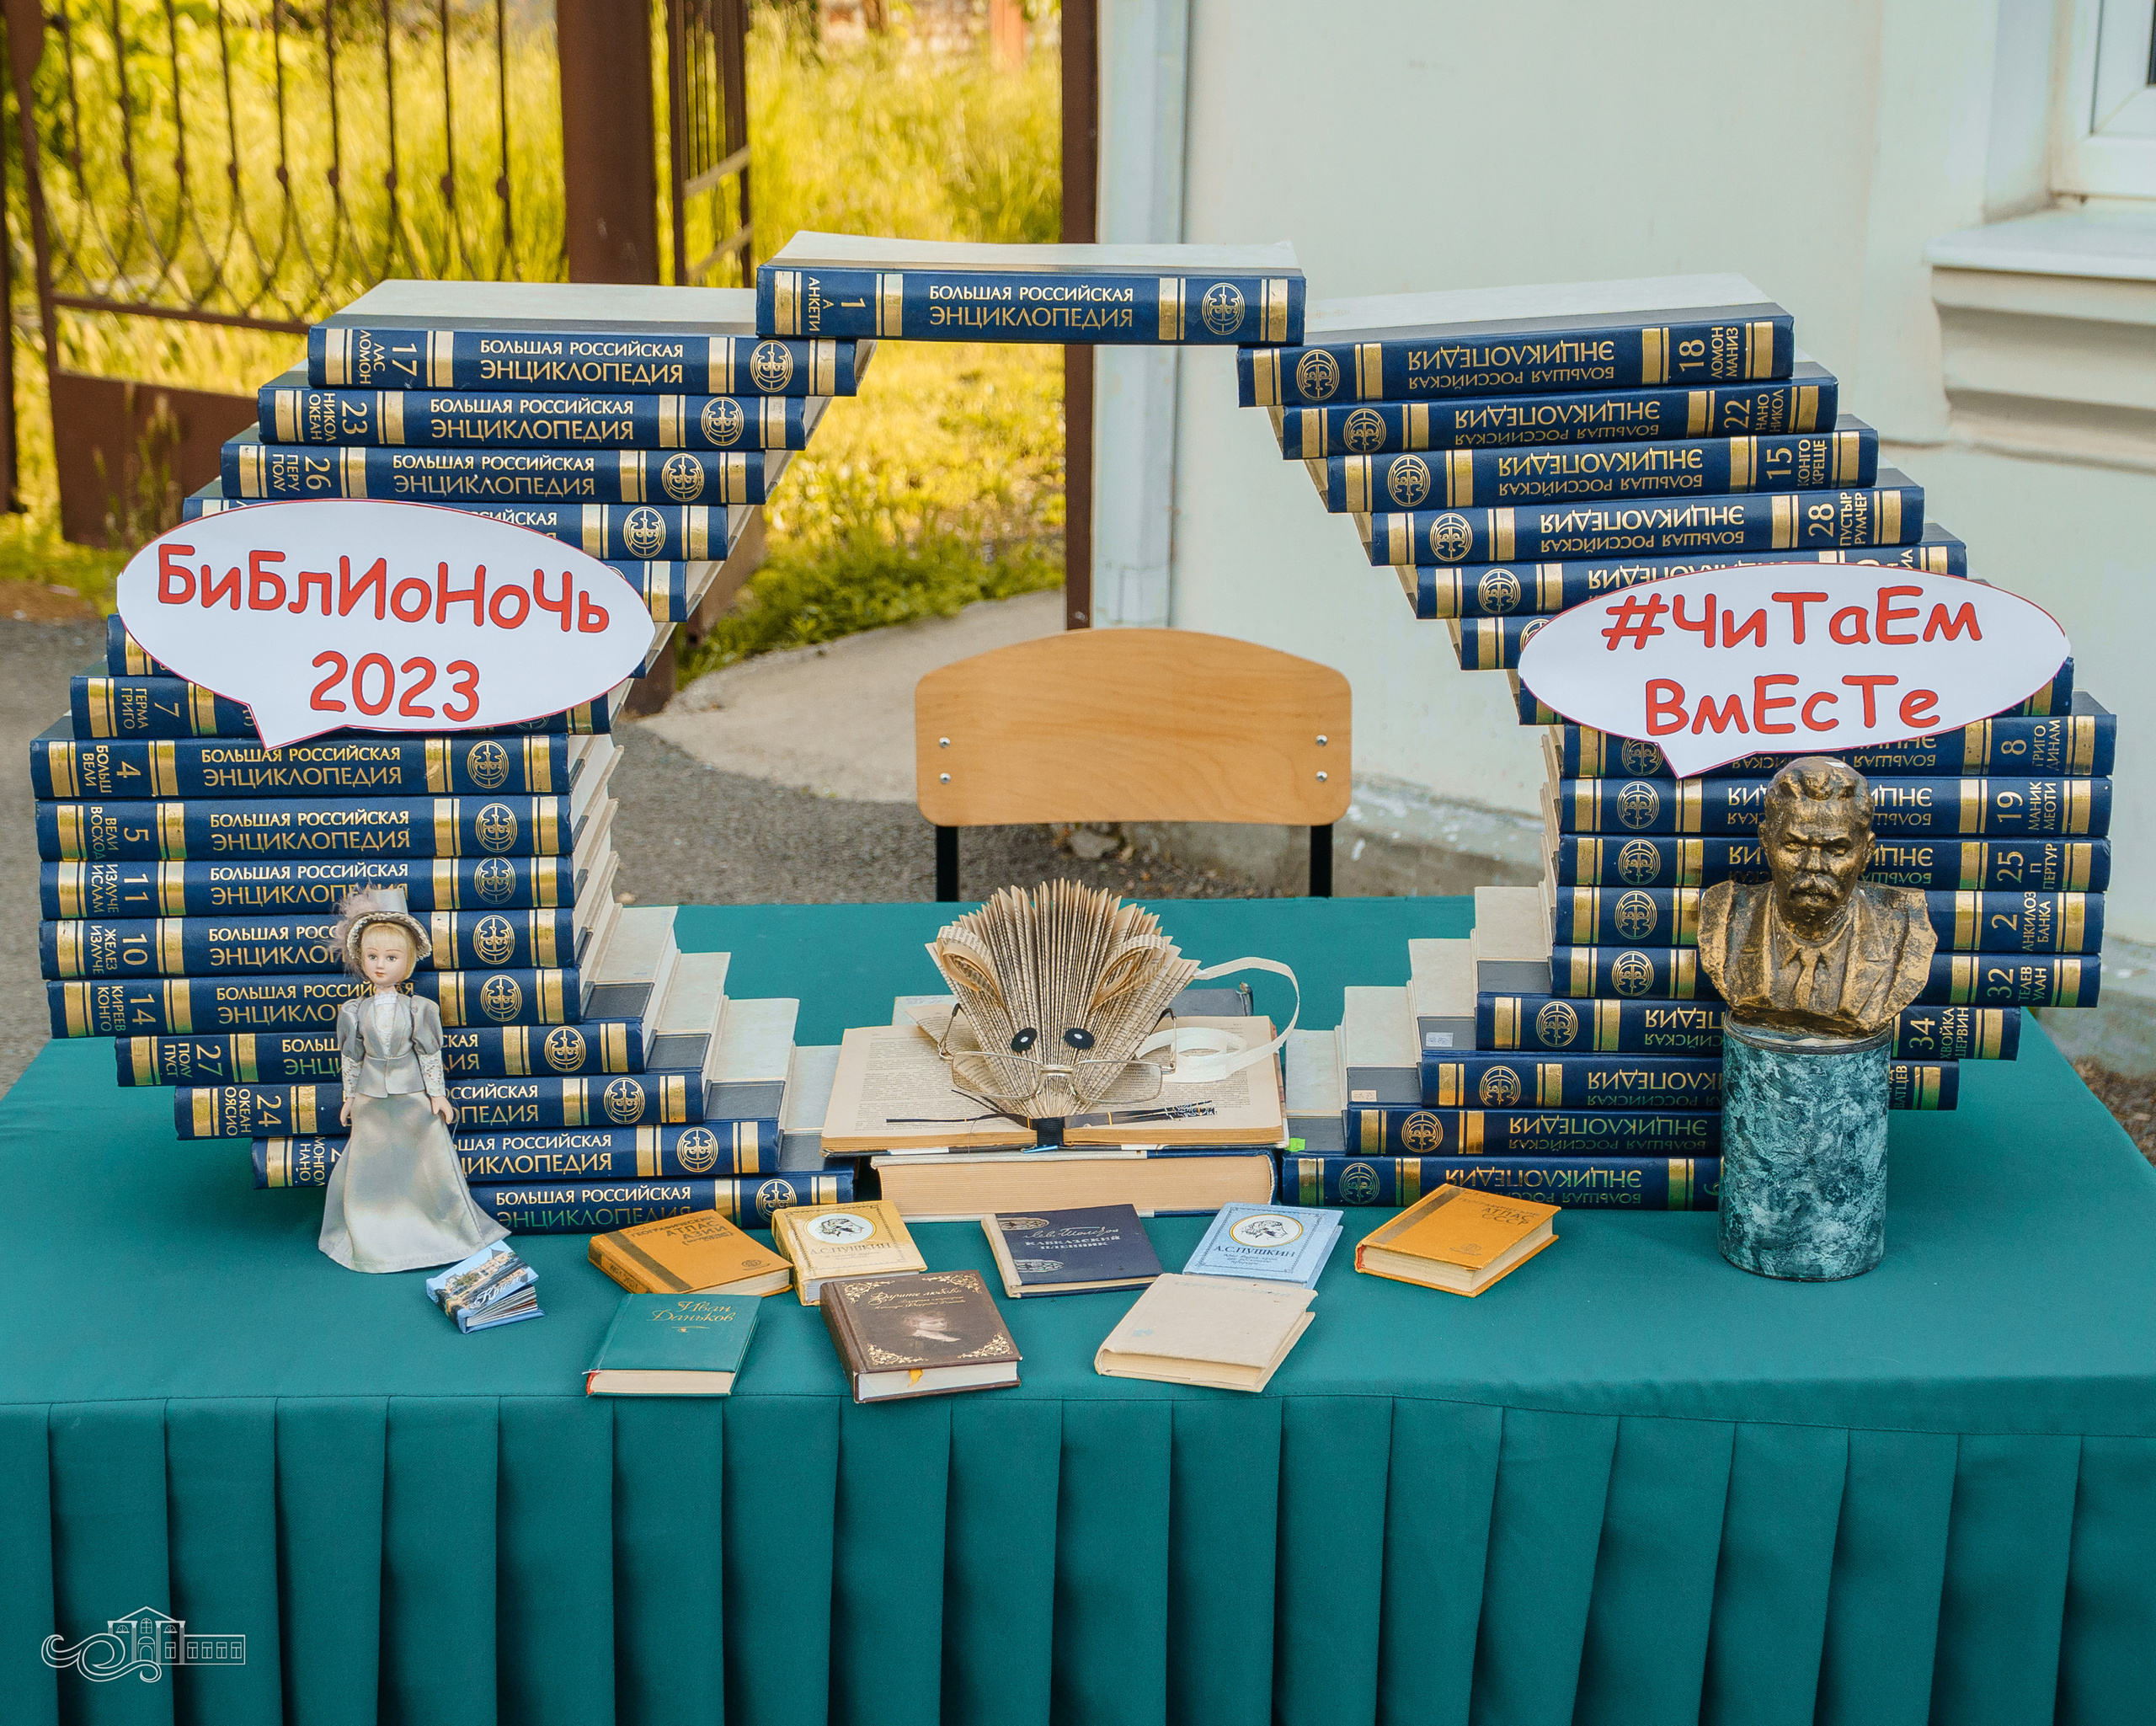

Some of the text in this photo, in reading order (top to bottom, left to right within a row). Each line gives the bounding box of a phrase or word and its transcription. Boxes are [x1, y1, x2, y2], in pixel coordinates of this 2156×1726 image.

[808, 276, 820, 332] АНКЕТИ
[823, 299, 835, 309] А
[841, 298, 866, 307] 1
[930, 285, 1134, 302] БОЛЬШАЯ РОССИЙСКАЯ
[929, 306, 1134, 330] ЭНЦИКЛОПЕДИЯ
[359, 329, 371, 384] ЛОМОН
[374, 343, 386, 371] ЛАС
[392, 343, 418, 377] 17
[480, 339, 684, 358] БОЛЬШАЯ РОССИЙСКАЯ
[1408, 339, 1614, 371] ЭНЦИКЛОПЕДИЯ
[1678, 339, 1705, 371] 18
[1710, 326, 1724, 379] ЛОМОН
[1726, 327, 1739, 377] МАНИЗ
[480, 359, 684, 387] ЭНЦИКЛОПЕДИЯ
[1409, 366, 1614, 390] БОЛЬШАЯ РОССИЙСКАЯ
[309, 393, 323, 441] ОКЕАН
[323, 393, 336, 442] НИКОЛ
[342, 400, 368, 435] 23
[430, 397, 633, 414] БОЛЬШАЯ РОССИЙСКАЯ
[1455, 399, 1660, 429] ЭНЦИКЛОПЕДИЯ
[1724, 398, 1750, 429] 22
[1755, 393, 1769, 430] НАНО
[1769, 388, 1785, 432] НИКОЛ
[431, 419, 633, 442] ЭНЦИКЛОПЕДИЯ
[1455, 424, 1659, 446] БОЛЬШАЯ РОССИЙСКАЯ
[272, 454, 286, 492] ПОЛУ
[287, 454, 301, 491] ПЕРУ
[305, 457, 331, 490] 26
[392, 454, 595, 472] БОЛЬШАЯ РОССИЙСКАЯ
[1499, 447, 1703, 477] ЭНЦИКЛОПЕДИЯ
[1766, 447, 1793, 480] 15
[1797, 439, 1811, 487] КОНГО
[1812, 440, 1828, 485] КРЕЩЕ
[393, 474, 595, 498] ЭНЦИКЛОПЕДИЯ
[1499, 474, 1702, 497] БОЛЬШАЯ РОССИЙСКАЯ
[1540, 504, 1744, 533] ЭНЦИКЛОПЕДИЯ
[1808, 503, 1835, 537] 28
[1839, 492, 1853, 546] ПУСТЫР
[1854, 492, 1868, 544] РУМЧЕР
[1541, 531, 1744, 553] БОЛЬШАЯ РОССИЙСКАЯ
[157, 543, 610, 633] БиБлИоНоЧь
[1601, 585, 1983, 651] #ЧиТаЕм
[309, 650, 480, 722] 2023
[121, 687, 136, 729] ГРИГО
[135, 688, 149, 729] ГЕРМА
[154, 703, 179, 718] 7
[1645, 674, 1940, 736] ВмЕсТе
[201, 745, 401, 763] БОЛЬШАЯ РОССИЙСКАЯ
[1854, 754, 1935, 767] БОЛЬШАЯ
[2001, 739, 2027, 756] 8
[2032, 724, 2047, 767] ГРИГО
[2047, 719, 2061, 772] ДИНАМ
[83, 753, 97, 787] ВЕЛИ
[96, 745, 112, 794] БОЛЬШ
[116, 761, 141, 778] 4
[203, 767, 403, 788] ЭНЦИКЛОПЕДИЯ
[211, 809, 409, 828] БОЛЬШАЯ РОССИЙСКАЯ
[1873, 813, 1931, 826] БОЛЬШ
[1997, 790, 2024, 823] 19
[2028, 781, 2042, 831] МАНИК
[2043, 782, 2057, 831] МЕОТИ
[90, 806, 106, 860] ВОСХОД
[104, 817, 119, 851] ВЕЛИ
[124, 827, 149, 842] 5
[211, 831, 410, 852] ЭНЦИКЛОПЕДИЯ
[211, 862, 408, 881] БОЛЬШАЯ РОССИЙСКАЯ
[1861, 871, 1932, 884] БОЛЬША
[1997, 851, 2024, 883] 25
[2030, 863, 2042, 873] П
[2042, 843, 2057, 890] ПЕРТУР
[91, 864, 104, 913] ИСЛАМ
[105, 864, 119, 913] ИЗЛУЧЕ
[124, 874, 149, 900] 11
[209, 927, 289, 942] БОЛЬШАЯ
[1992, 914, 2018, 931] 2
[2021, 891, 2036, 952] АНКИЛОЗ
[2037, 900, 2052, 943] БАНКА
[90, 925, 104, 975] ИЗЛУЧЕ
[104, 928, 118, 970] ЖЕЛЕЗ
[122, 933, 148, 965] 10
[216, 986, 296, 1001] БОЛЬШАЯ
[1988, 968, 2015, 998] 32
[2018, 966, 2032, 1002] ТЕЛЕВ
[2032, 968, 2047, 1002] УЛАН
[97, 986, 112, 1032] КОНГО
[111, 986, 126, 1032] КИРЕЕВ
[130, 993, 156, 1025] 14
[282, 1038, 341, 1052] БОЛЬШ
[1645, 1034, 1723, 1049] СИЙСКАЯ
[1908, 1018, 1935, 1050] 34
[1940, 1007, 1955, 1059] ХВОЙКА
[164, 1045, 179, 1077] ПУСТ
[179, 1043, 193, 1078] ПОЛУ
[196, 1044, 223, 1077] 27
[224, 1087, 237, 1136] ОЯСИО
[238, 1088, 252, 1133] ОКЕАН
[256, 1094, 282, 1127] 24
[1509, 1114, 1708, 1136] ЭНЦИКЛОПЕДИЯ
[503, 1134, 611, 1150] РОССИЙСКАЯ
[1508, 1139, 1705, 1152] БОЛЬШАЯ РОССИЙСКАЯ
[299, 1143, 312, 1181] НАНО
[1446, 1167, 1641, 1187] ЭНЦИКЛОПЕДИЯ
[496, 1186, 691, 1205] БОЛЬШАЯ РОССИЙСКАЯ
[1562, 1192, 1641, 1204] БОЛЬШАЯ
[683, 1226, 727, 1241] АЗИИ
[1481, 1212, 1529, 1226] СССР
[646, 1309, 736, 1322] Даньков
[677, 1301, 731, 1312] Иван
